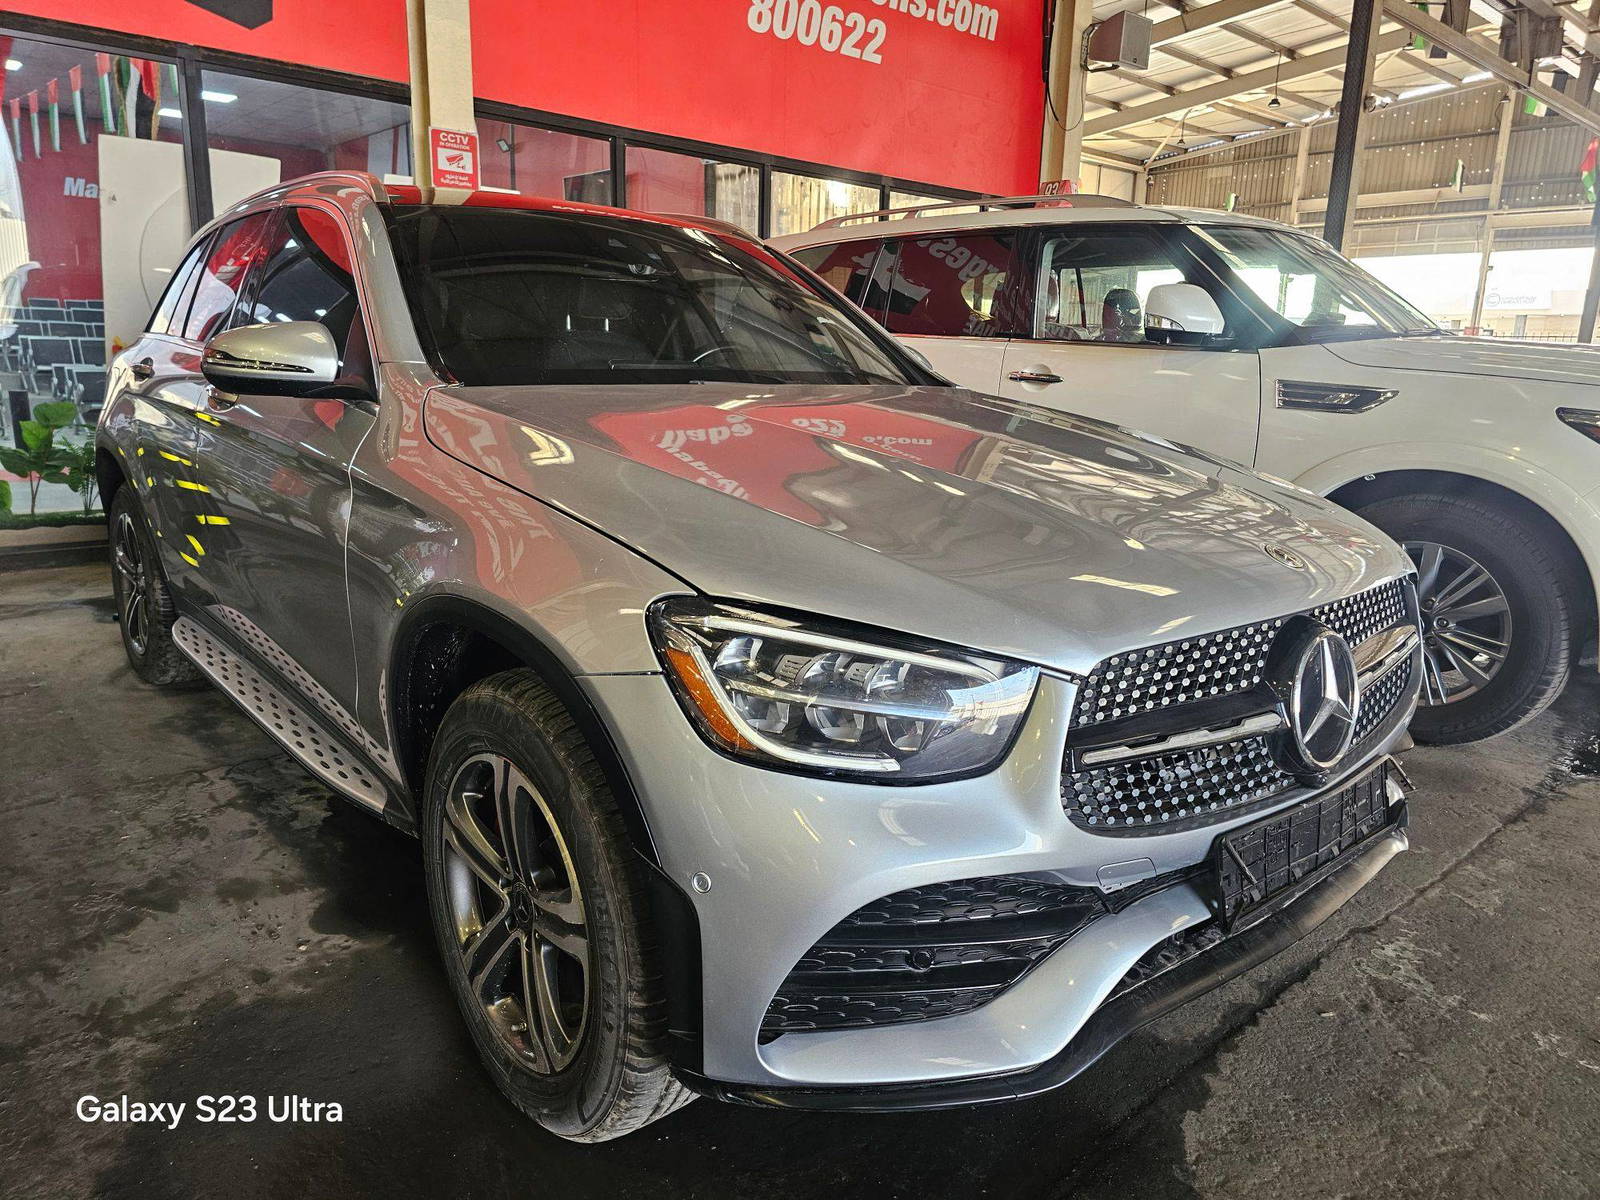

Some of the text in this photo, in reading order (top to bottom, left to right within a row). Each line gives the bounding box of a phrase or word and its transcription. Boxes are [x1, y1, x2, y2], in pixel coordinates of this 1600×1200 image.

[747, 0, 887, 64] 800622
[440, 132, 469, 145] CCTV
[63, 176, 99, 199] Ma
